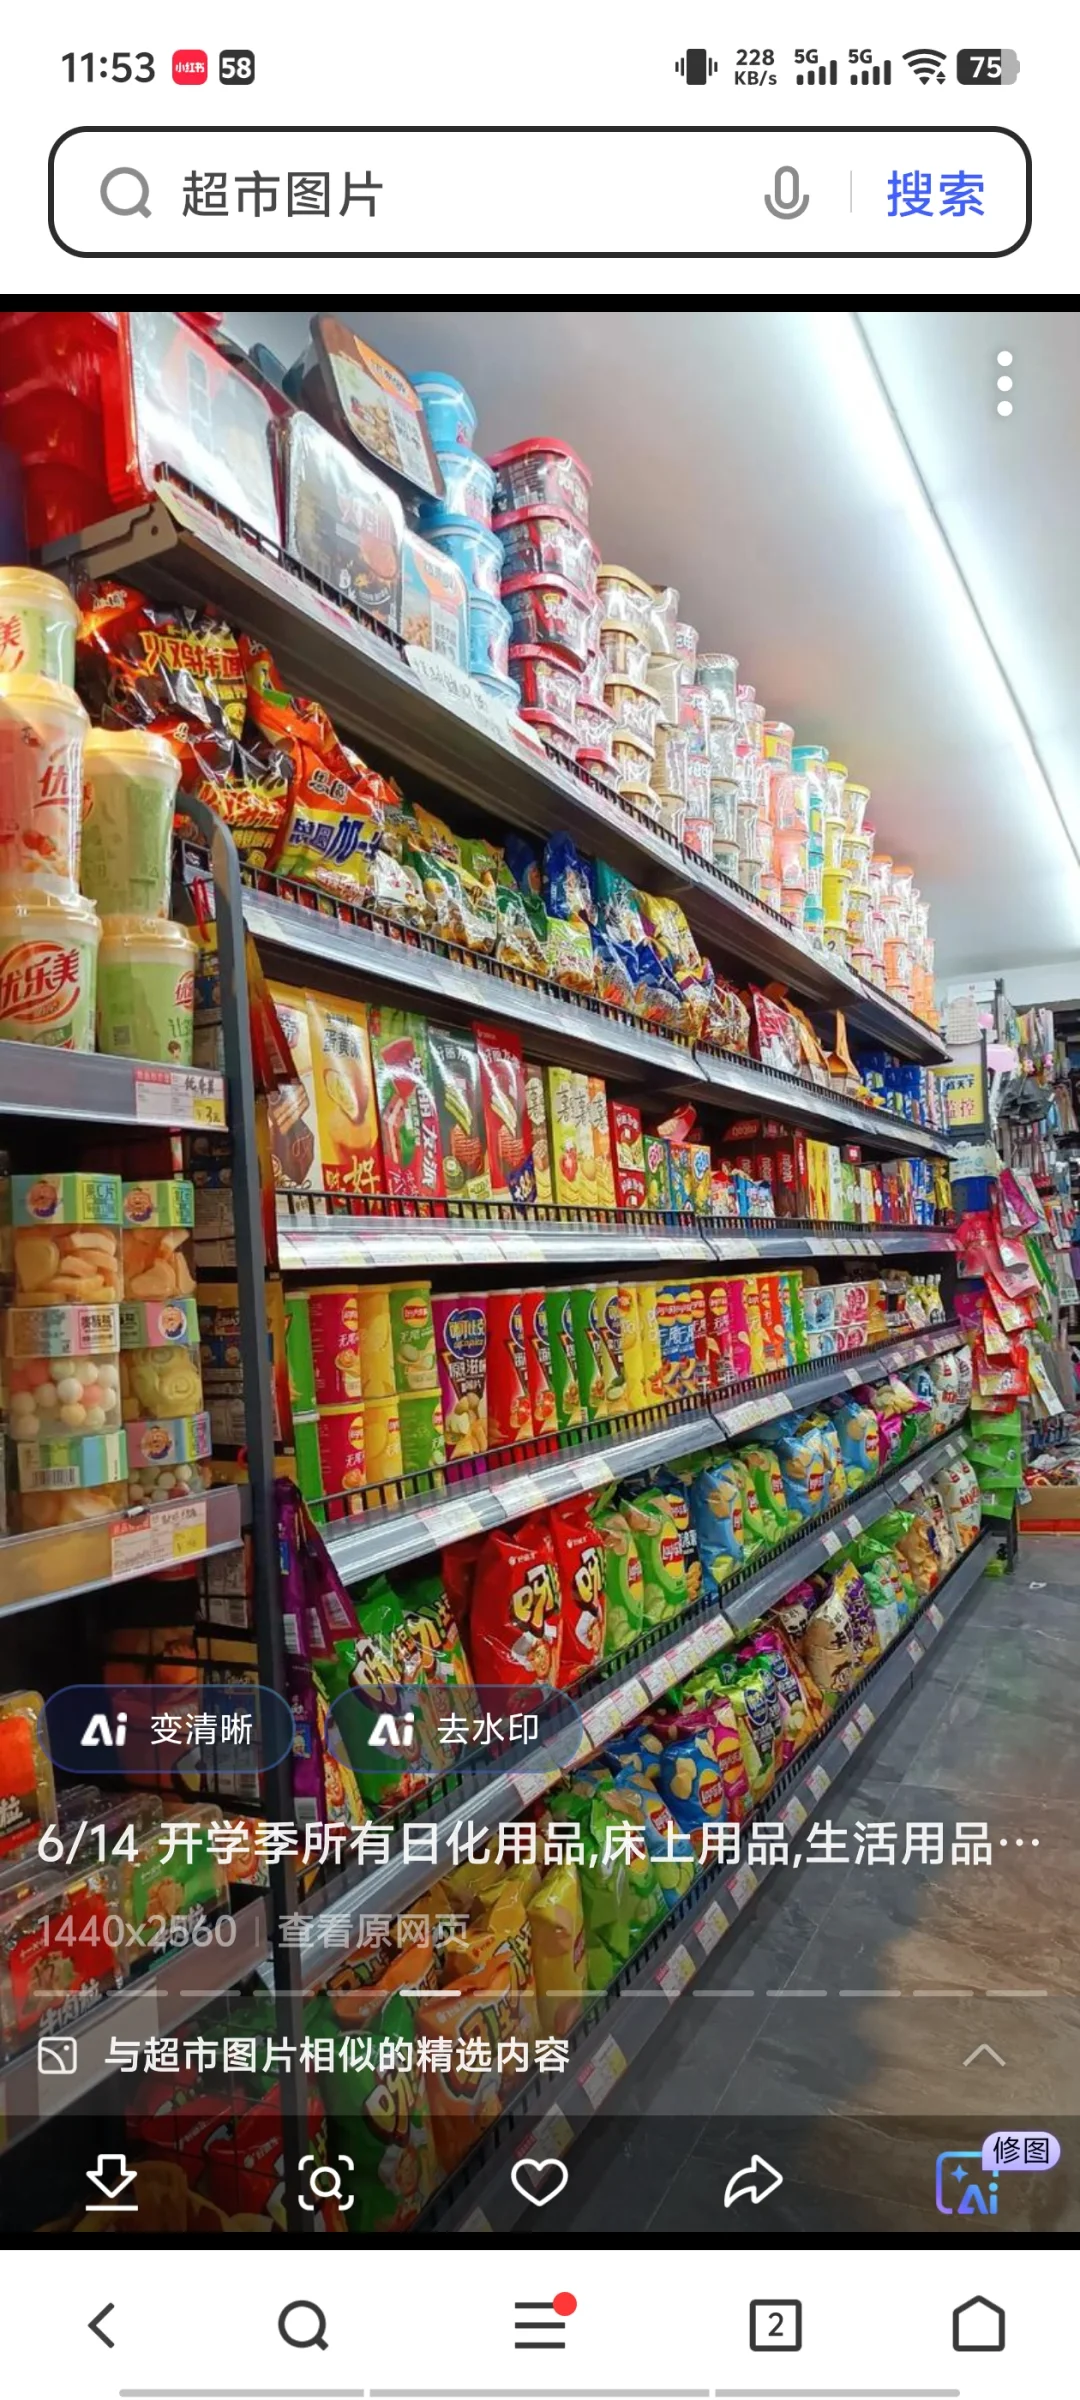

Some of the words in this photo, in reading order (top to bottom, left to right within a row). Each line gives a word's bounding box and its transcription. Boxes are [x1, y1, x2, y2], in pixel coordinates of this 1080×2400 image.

[175, 61, 205, 73] 小红书
[736, 49, 775, 66] 228
[794, 48, 819, 64] 5G
[848, 48, 873, 64] 5G
[62, 52, 155, 83] 11:53
[221, 57, 252, 79] 58
[734, 70, 778, 87] KB/s
[969, 56, 1002, 79] 75
[181, 169, 385, 220] 超市图片
[886, 169, 987, 220] 搜索
[0, 948, 80, 1004] 优乐美
[767, 2312, 785, 2337] 2
